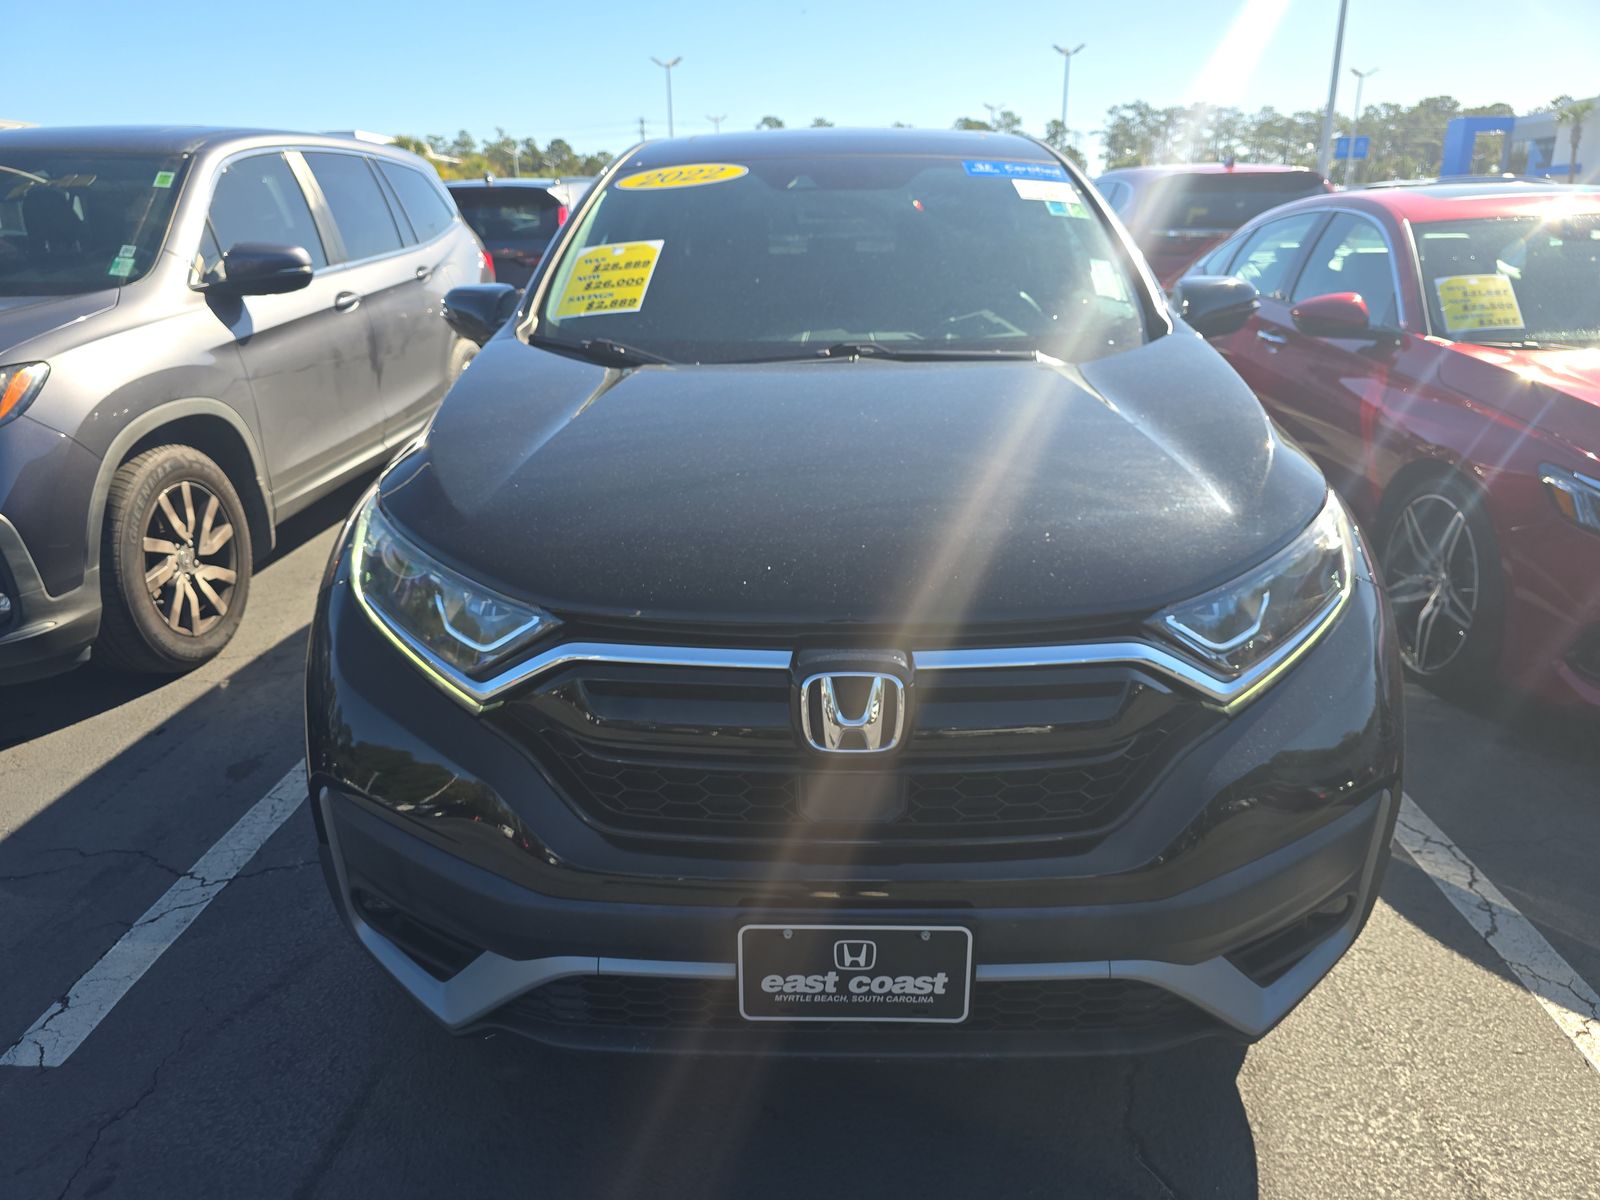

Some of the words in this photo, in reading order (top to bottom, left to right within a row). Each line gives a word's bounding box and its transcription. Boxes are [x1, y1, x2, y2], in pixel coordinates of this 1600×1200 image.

[637, 166, 727, 187] 2022
[577, 273, 601, 282] NOW
[584, 277, 645, 291] $26,000
[760, 971, 839, 994] east
[848, 972, 949, 995] coast
[774, 994, 813, 1003] MYRTLE
[814, 995, 849, 1004] BEACH,
[851, 995, 884, 1003] SOUTH
[885, 995, 934, 1004] CAROLINA
